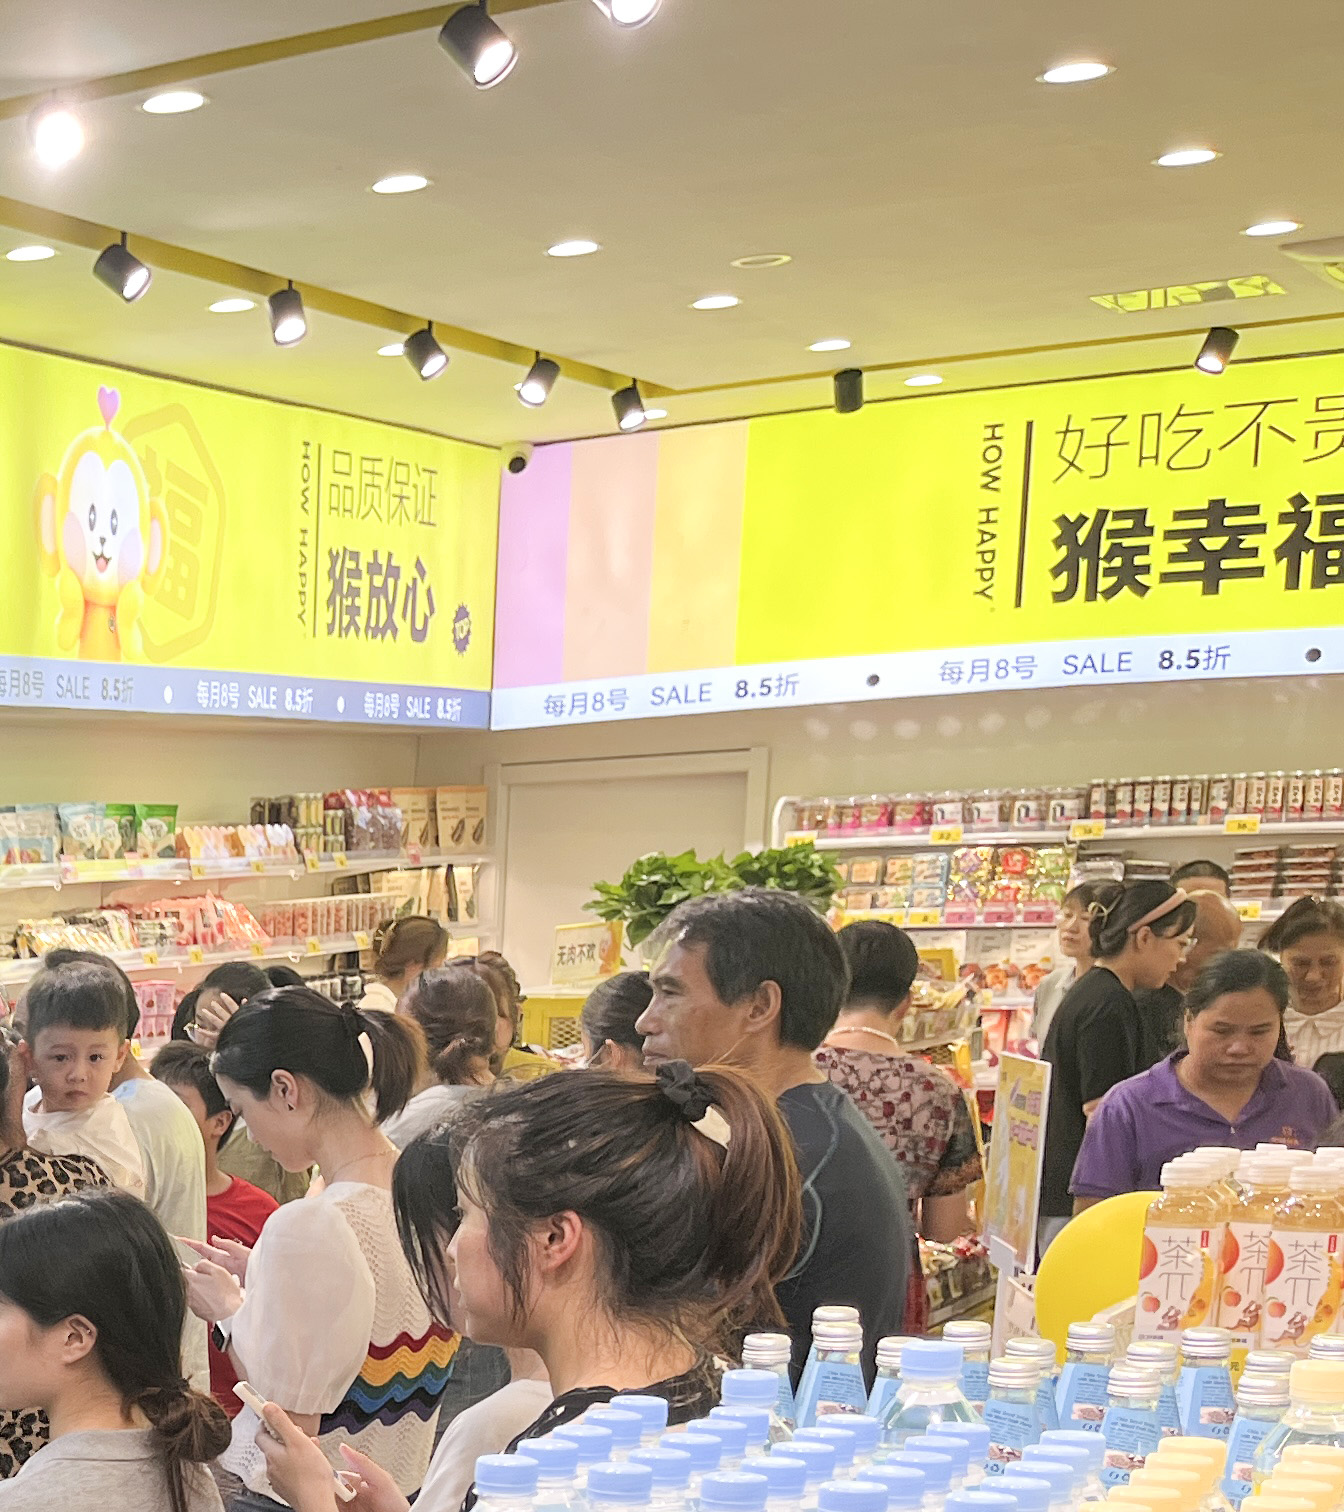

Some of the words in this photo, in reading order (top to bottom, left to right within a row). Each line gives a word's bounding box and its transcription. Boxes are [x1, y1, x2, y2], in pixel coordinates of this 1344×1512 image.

[301, 441, 311, 514] HOW
[328, 448, 438, 528] 品质保证
[981, 422, 1004, 493] HOW
[298, 528, 310, 627] HAPPY
[973, 506, 1000, 602] HAPPY
[325, 545, 436, 643] 猴放心
[55, 674, 91, 701] SALE
[100, 676, 134, 705] 8.5折
[196, 679, 240, 710] 每月8号
[247, 684, 278, 710] SALE
[284, 686, 314, 714] 8.5折
[543, 686, 630, 719] 每月8号
[650, 681, 714, 707] SALE
[735, 672, 801, 701] 8.5折
[938, 652, 1040, 687] 每月8号
[1062, 650, 1134, 676] SALE
[1157, 643, 1232, 673] 8.5折
[362, 690, 401, 720] 每月8号
[405, 694, 431, 720] SALE
[436, 696, 462, 722] 8.5折
